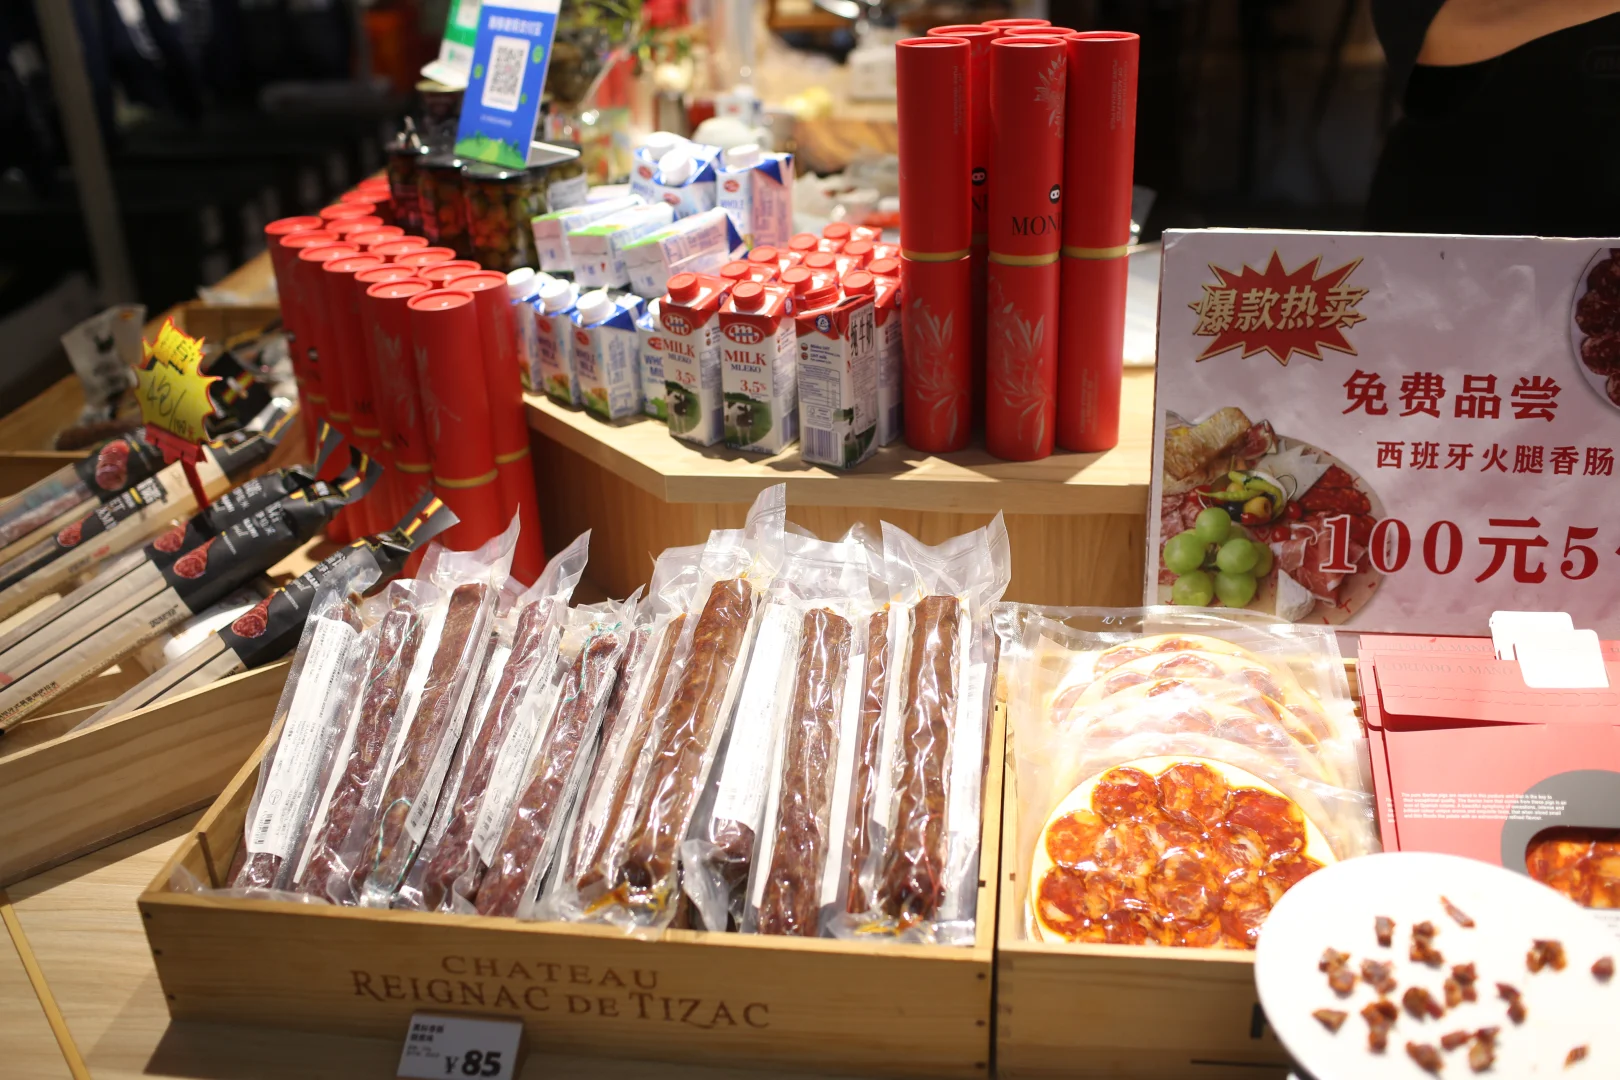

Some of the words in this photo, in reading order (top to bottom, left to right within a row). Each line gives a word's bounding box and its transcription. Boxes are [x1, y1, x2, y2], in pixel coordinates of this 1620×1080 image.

[1198, 284, 1367, 332] 爆款热卖
[662, 338, 696, 358] MILK
[724, 350, 768, 366] MILK
[731, 363, 762, 374] MLEKO
[1342, 368, 1562, 422] 免费品尝
[1376, 440, 1615, 477] 西班牙火腿香肠
[1318, 514, 1620, 584] 100元5
[1382, 662, 1452, 673] CORTADO
[1468, 664, 1514, 676] MANO
[440, 954, 659, 991] CHATEAU
[351, 970, 550, 1012] REIGNAC
[564, 993, 620, 1018] DE
[628, 992, 770, 1030] TIZAC
